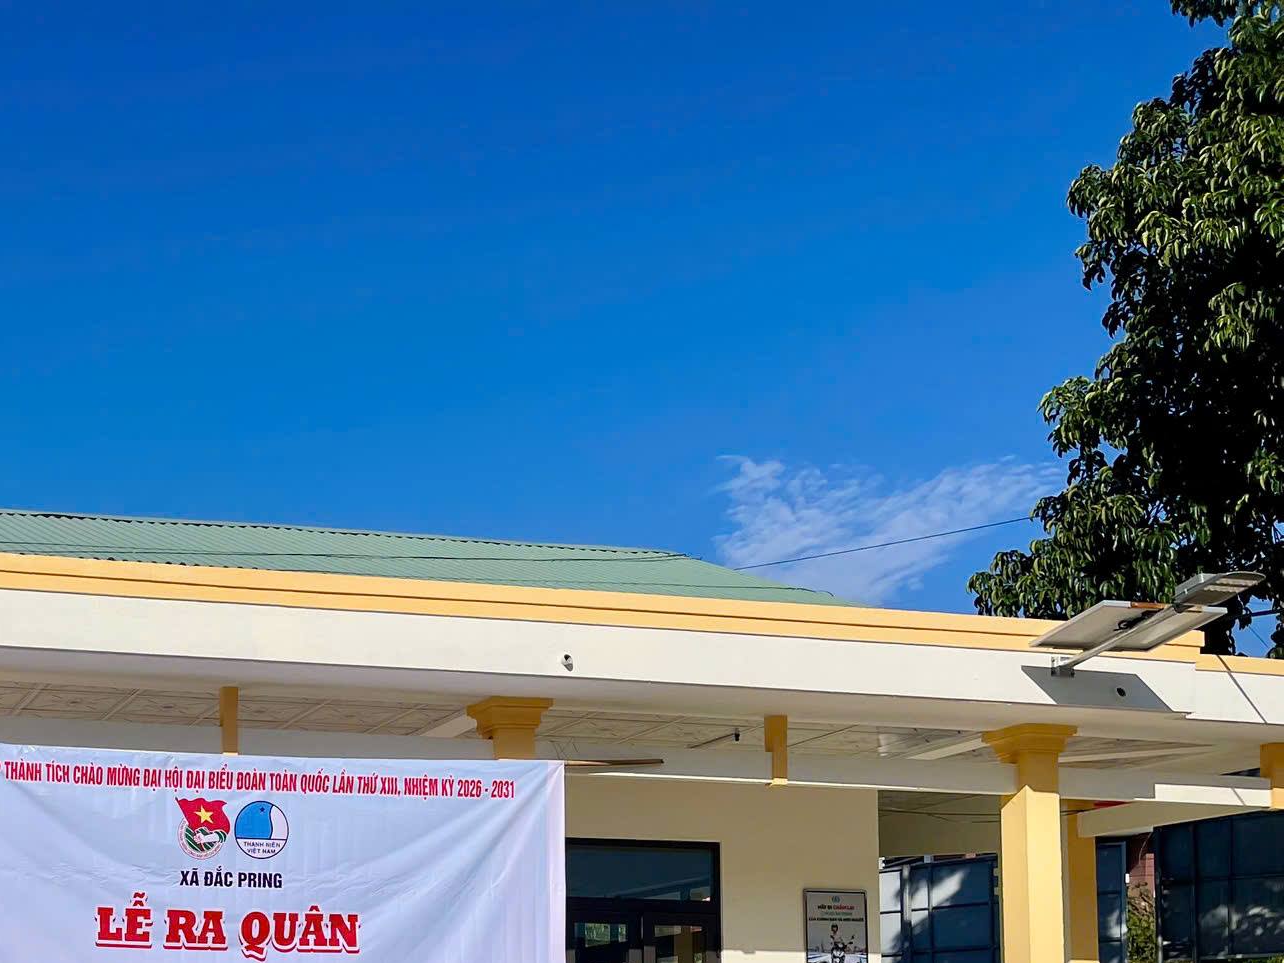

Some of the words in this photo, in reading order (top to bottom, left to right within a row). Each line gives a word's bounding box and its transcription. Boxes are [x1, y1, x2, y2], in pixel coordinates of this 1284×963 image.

[5, 759, 41, 781] THÀNH
[46, 760, 70, 782] TÍCH
[73, 763, 102, 785] CHÀO
[107, 764, 140, 786] MỪNG
[143, 769, 161, 790] ĐẠI
[165, 767, 182, 793] HỘI
[186, 770, 204, 793] ĐẠI
[208, 764, 233, 790] BIỂU
[236, 769, 265, 791] ĐOÀN
[269, 771, 296, 792] TOÀN
[301, 769, 329, 794] QUỐC
[333, 769, 353, 793] LẦN
[357, 772, 378, 794] THỨ
[380, 777, 400, 796] XIII,
[404, 776, 438, 799] NHIỆM
[458, 780, 481, 797] 2026
[491, 781, 515, 798] 2031
[180, 868, 199, 886] XÃ
[204, 865, 233, 887] ĐẮC
[238, 872, 282, 888] PRING
[96, 892, 152, 947] LỄ
[165, 910, 226, 948] RA
[240, 905, 359, 957] QUÂN
